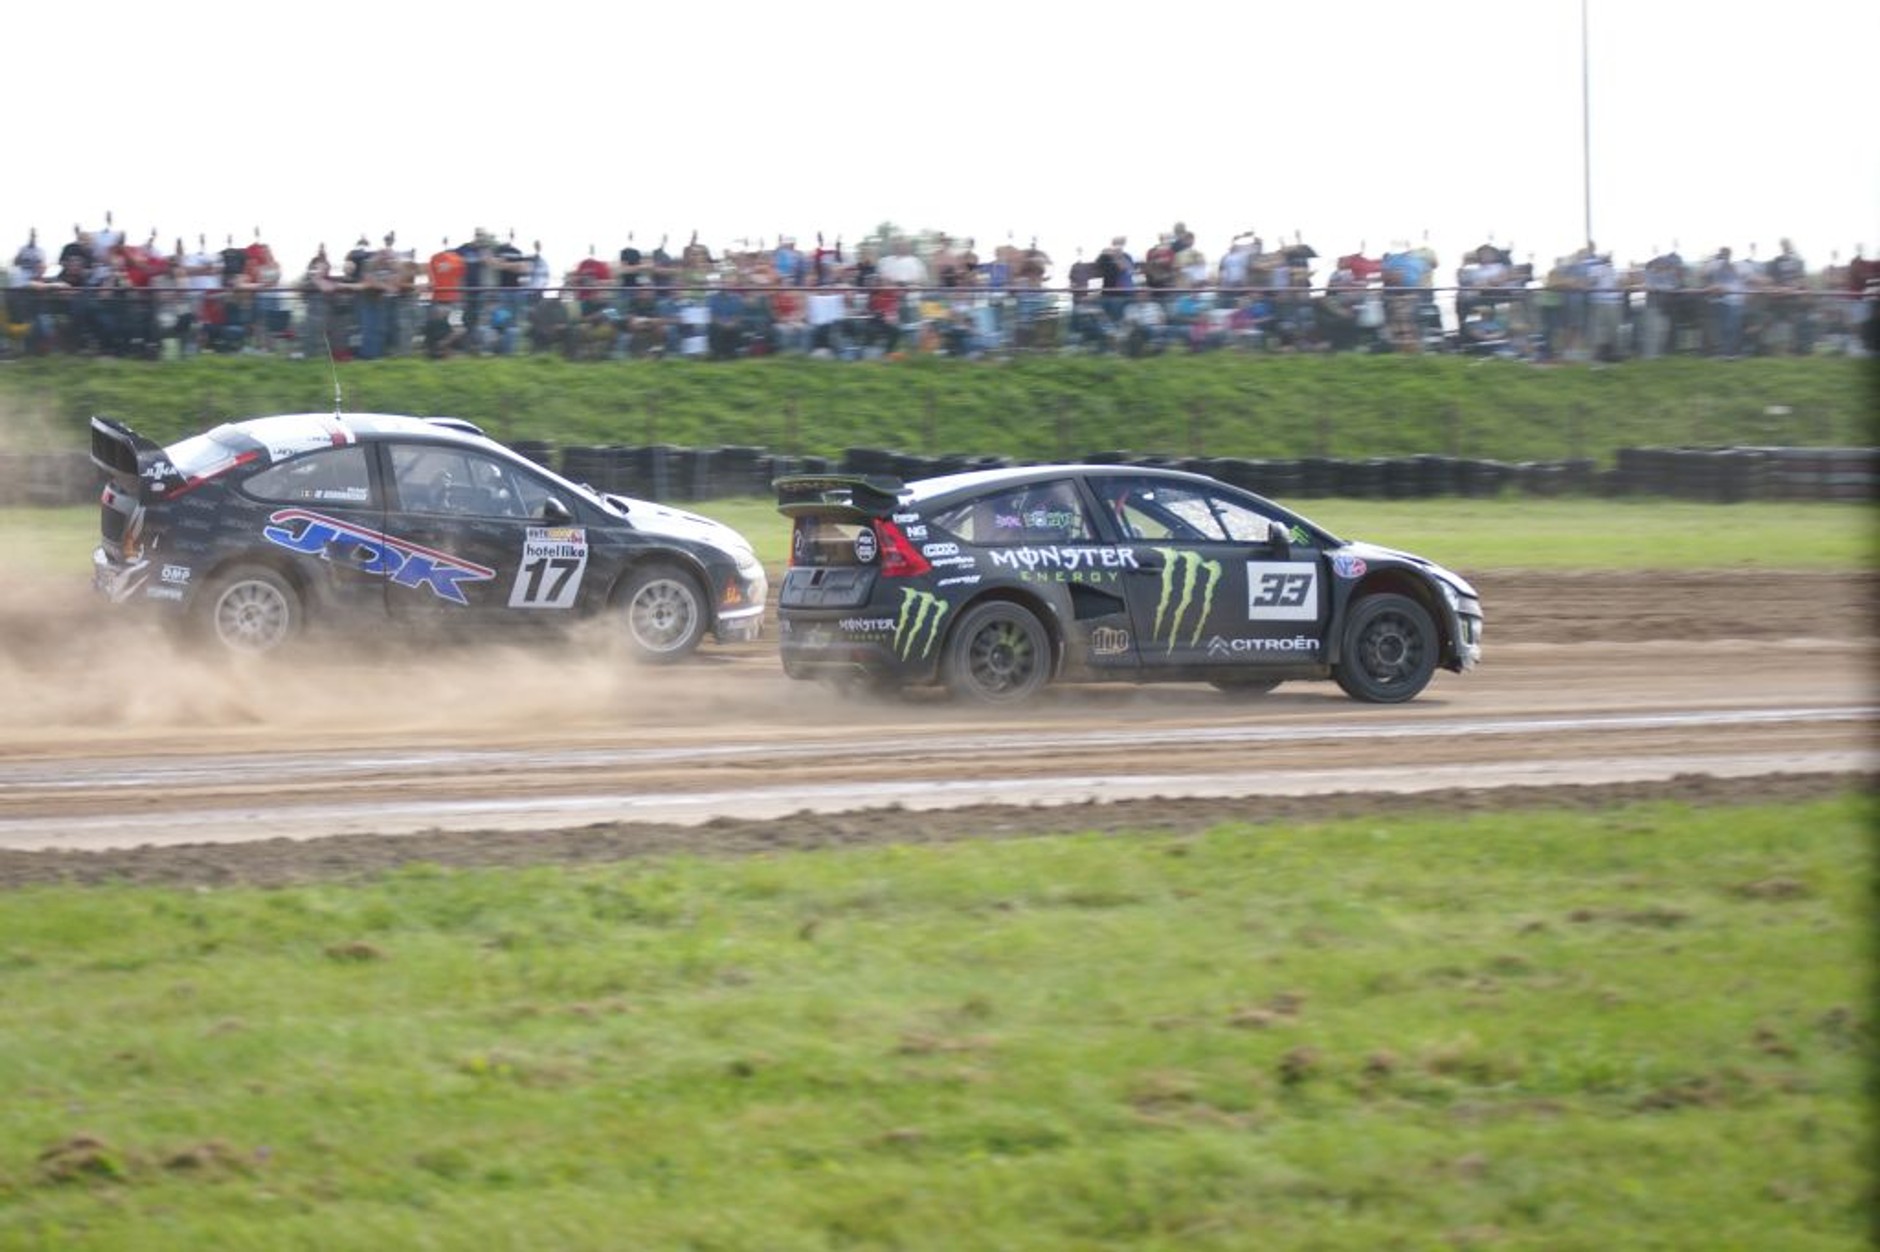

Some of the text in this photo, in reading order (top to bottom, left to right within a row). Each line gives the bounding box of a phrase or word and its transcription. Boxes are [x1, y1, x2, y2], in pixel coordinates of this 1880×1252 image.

[263, 509, 496, 605] JDK
[526, 544, 560, 557] hotel
[988, 545, 1139, 571] MONSTER
[523, 558, 581, 603] 17
[1020, 571, 1118, 582] ENERGY
[1252, 573, 1313, 607] 33
